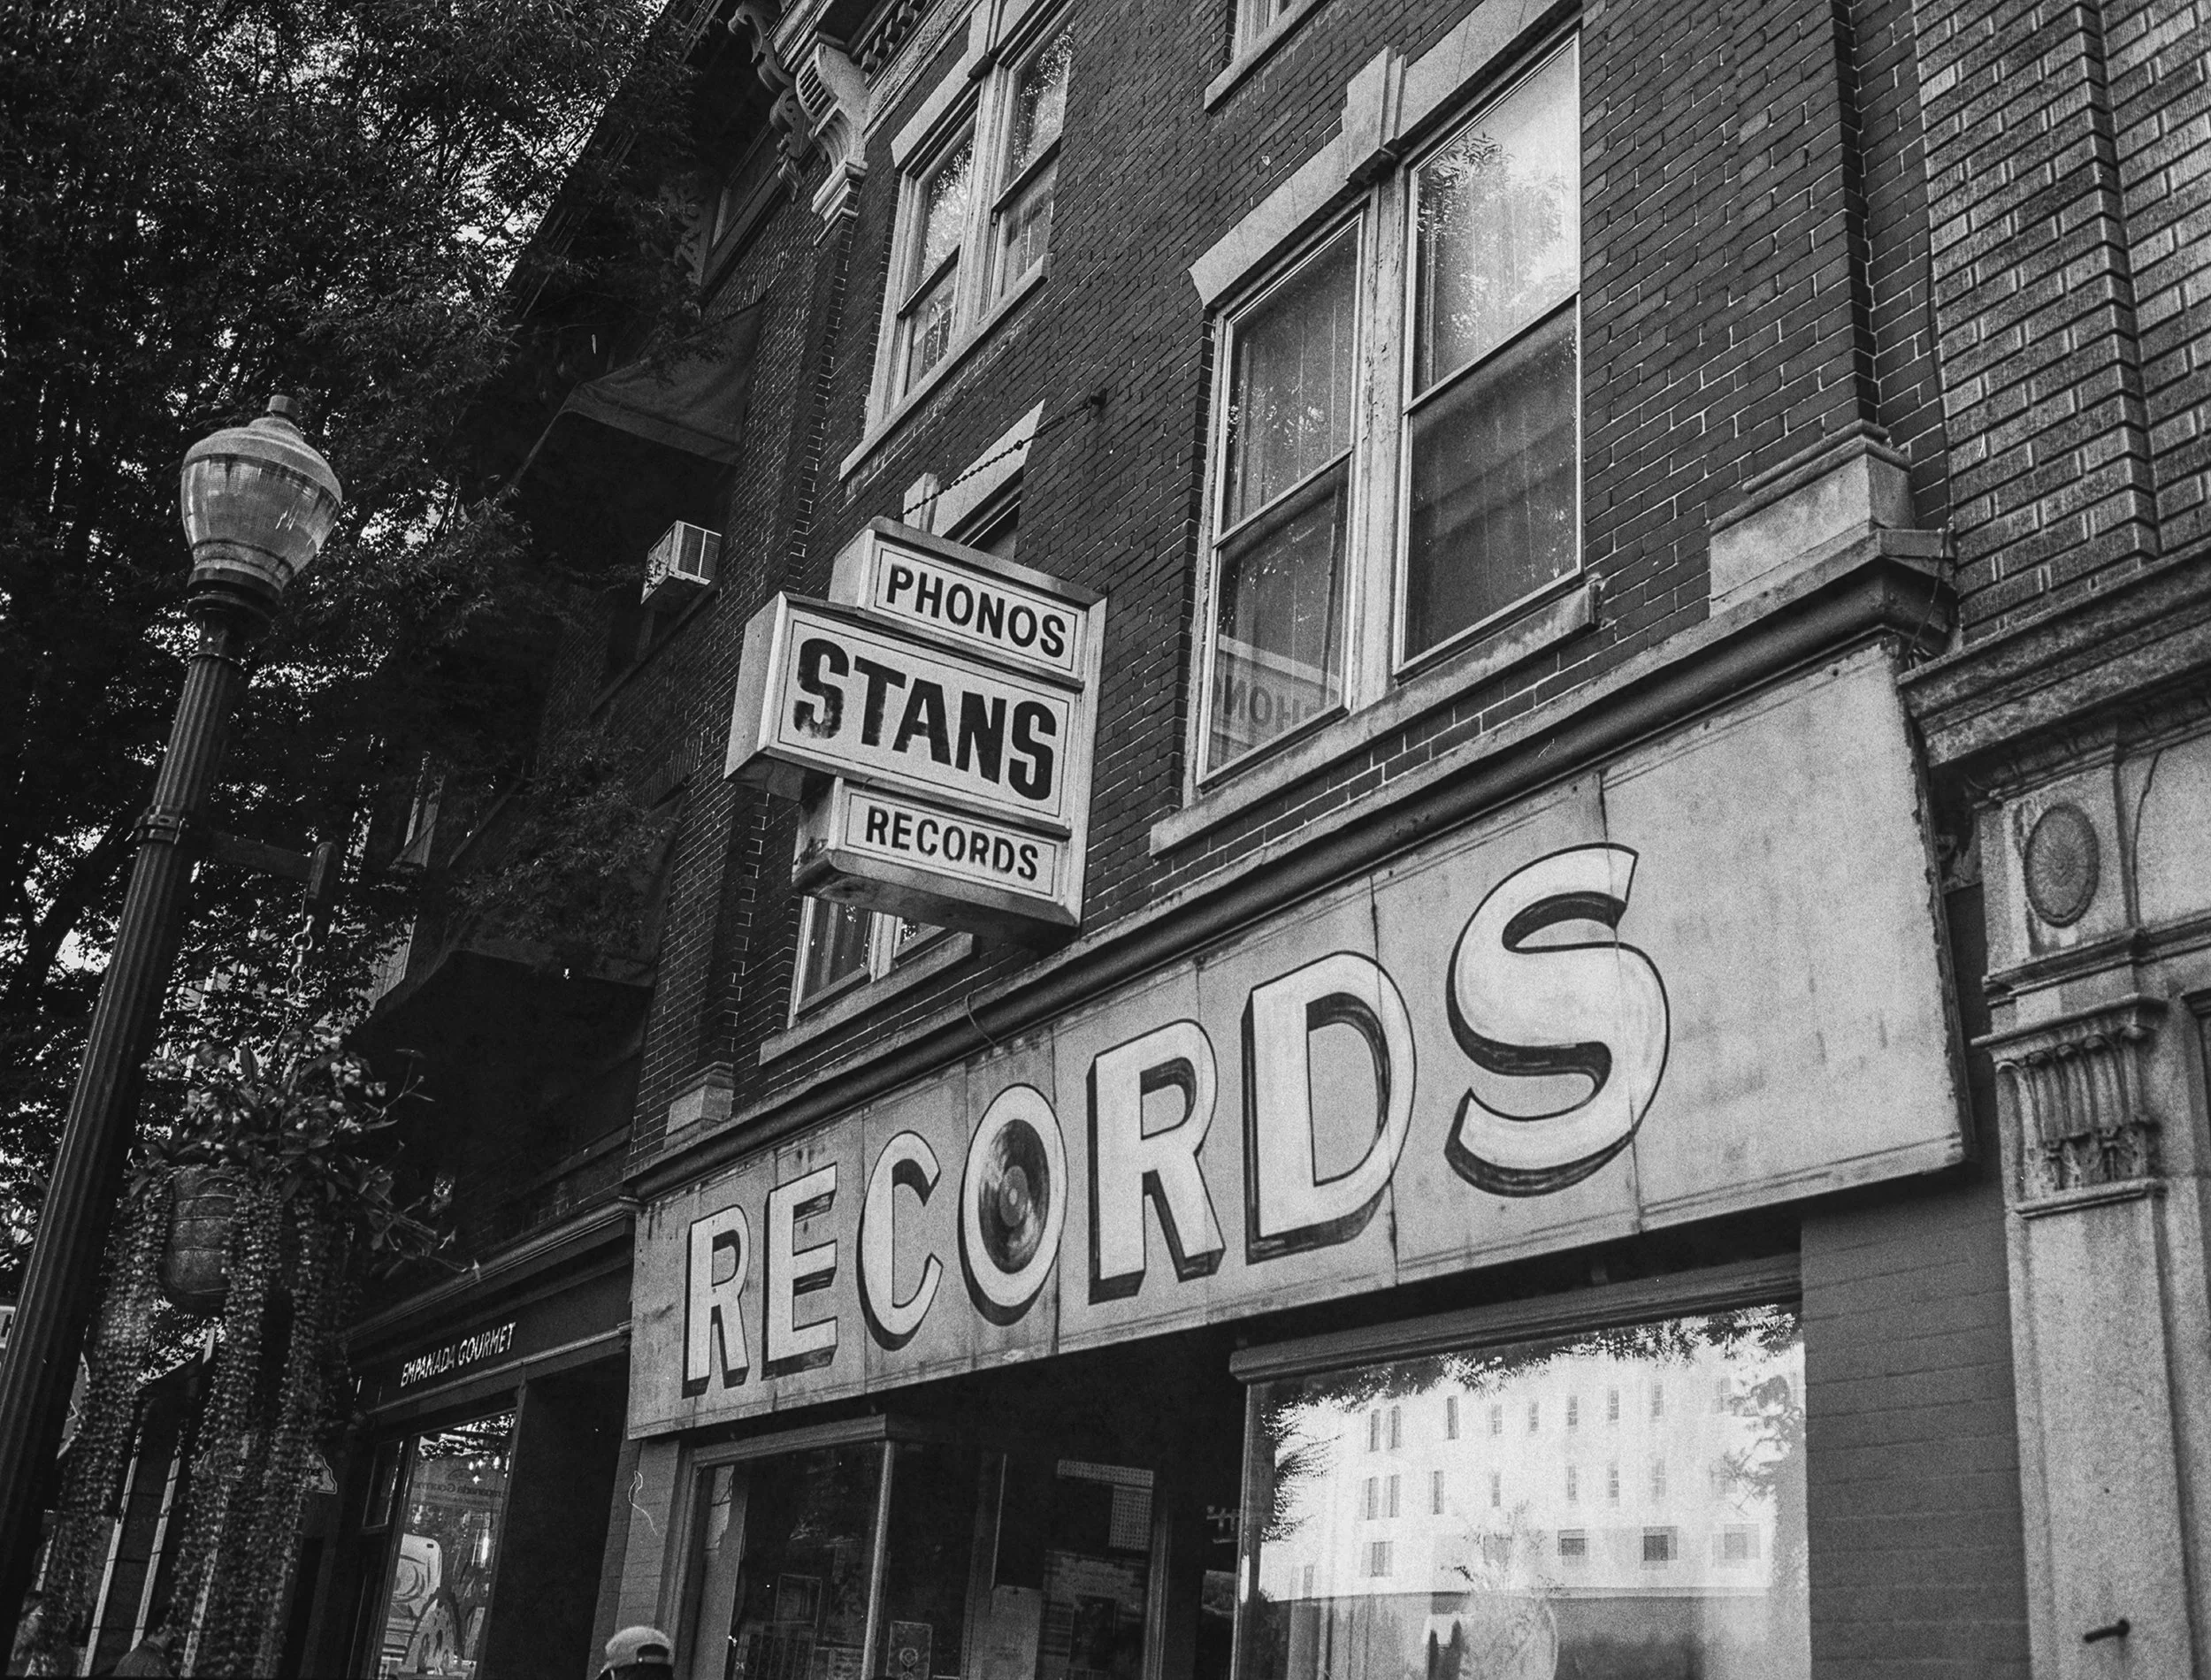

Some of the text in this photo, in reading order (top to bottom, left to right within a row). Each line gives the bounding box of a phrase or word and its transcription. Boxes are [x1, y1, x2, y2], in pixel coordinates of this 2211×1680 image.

[886, 563, 1067, 658] PHONOS
[793, 638, 1057, 801] STANS
[865, 806, 1039, 882] RECORDS
[681, 843, 1671, 1398] RECORDS
[400, 1321, 516, 1387] EMPANADA GOURMET
